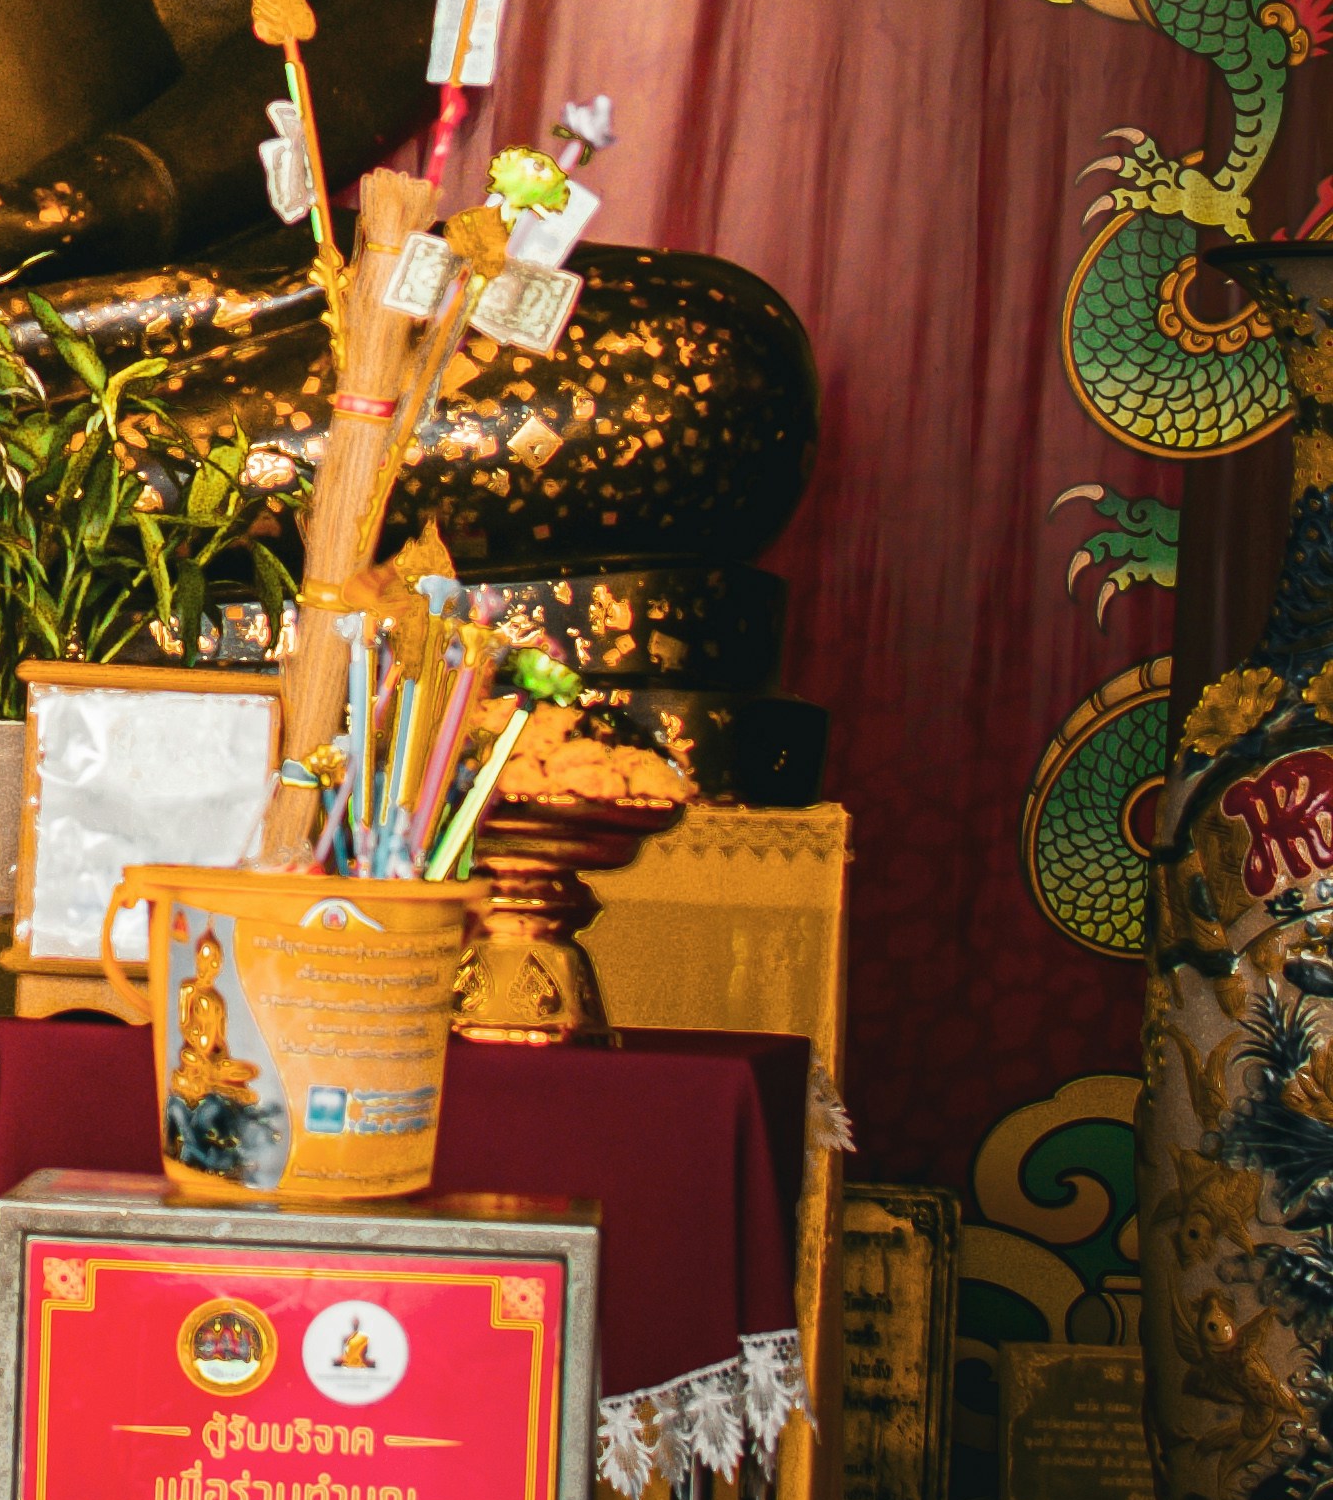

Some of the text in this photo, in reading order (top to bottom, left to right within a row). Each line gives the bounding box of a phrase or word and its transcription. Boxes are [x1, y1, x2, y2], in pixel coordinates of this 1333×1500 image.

[201, 1410, 375, 1460] ตู้รับบริจาค
